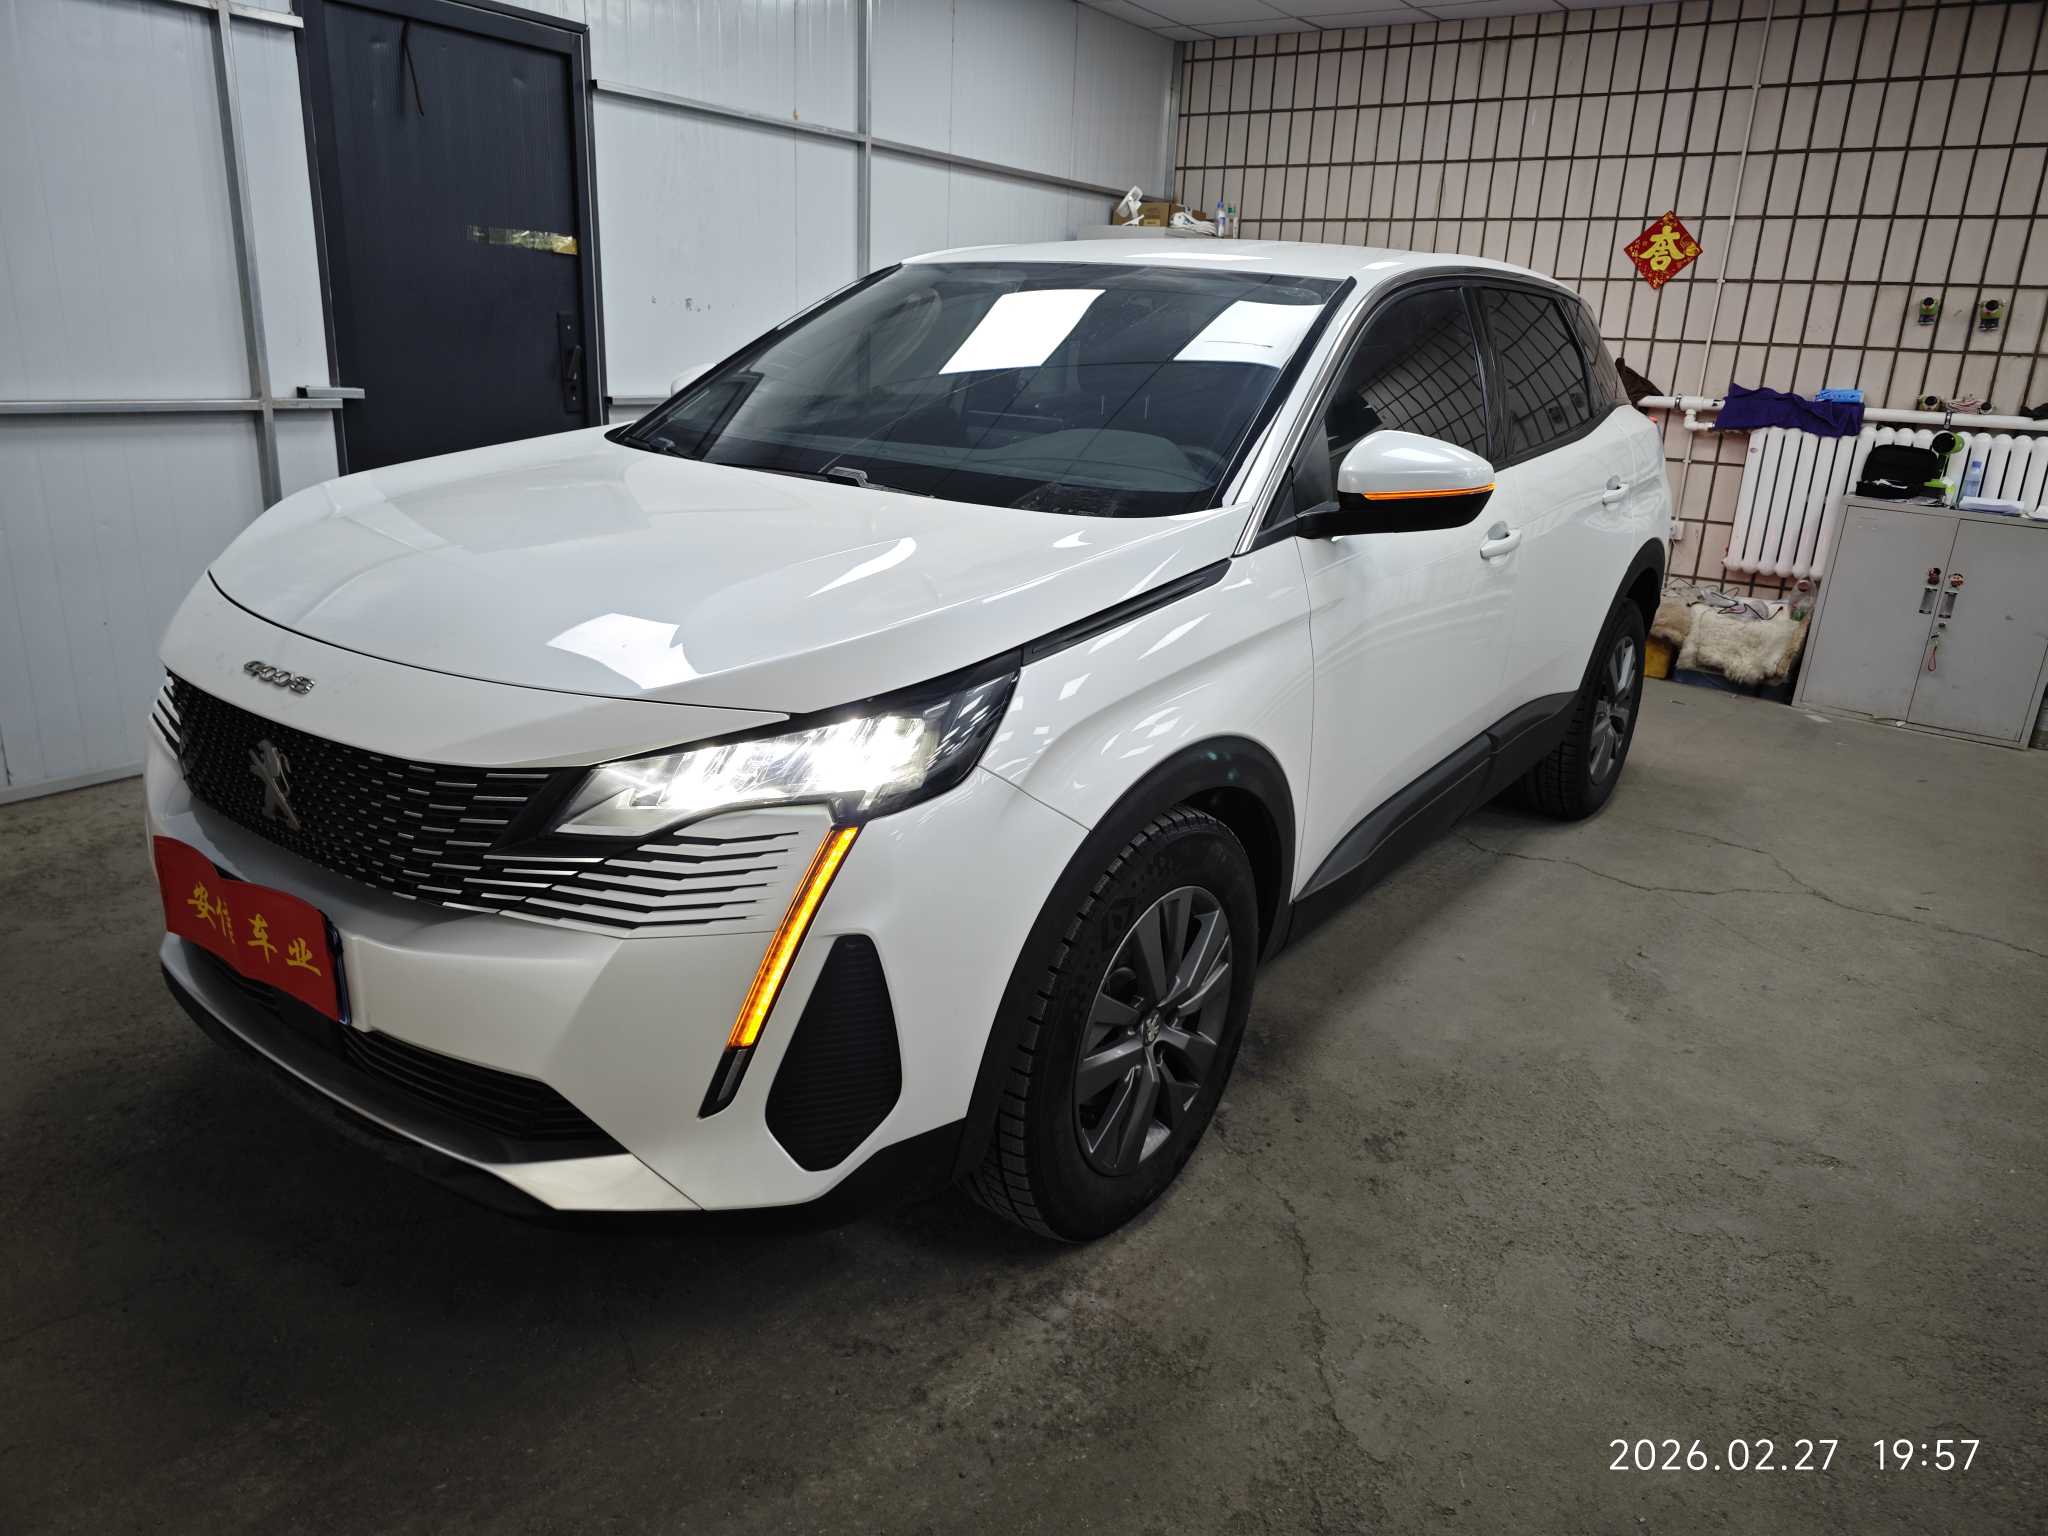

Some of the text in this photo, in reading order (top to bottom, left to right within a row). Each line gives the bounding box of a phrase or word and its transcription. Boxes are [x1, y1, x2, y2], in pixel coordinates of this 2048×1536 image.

[243, 660, 316, 695] 4008
[186, 880, 322, 976] 安信车业
